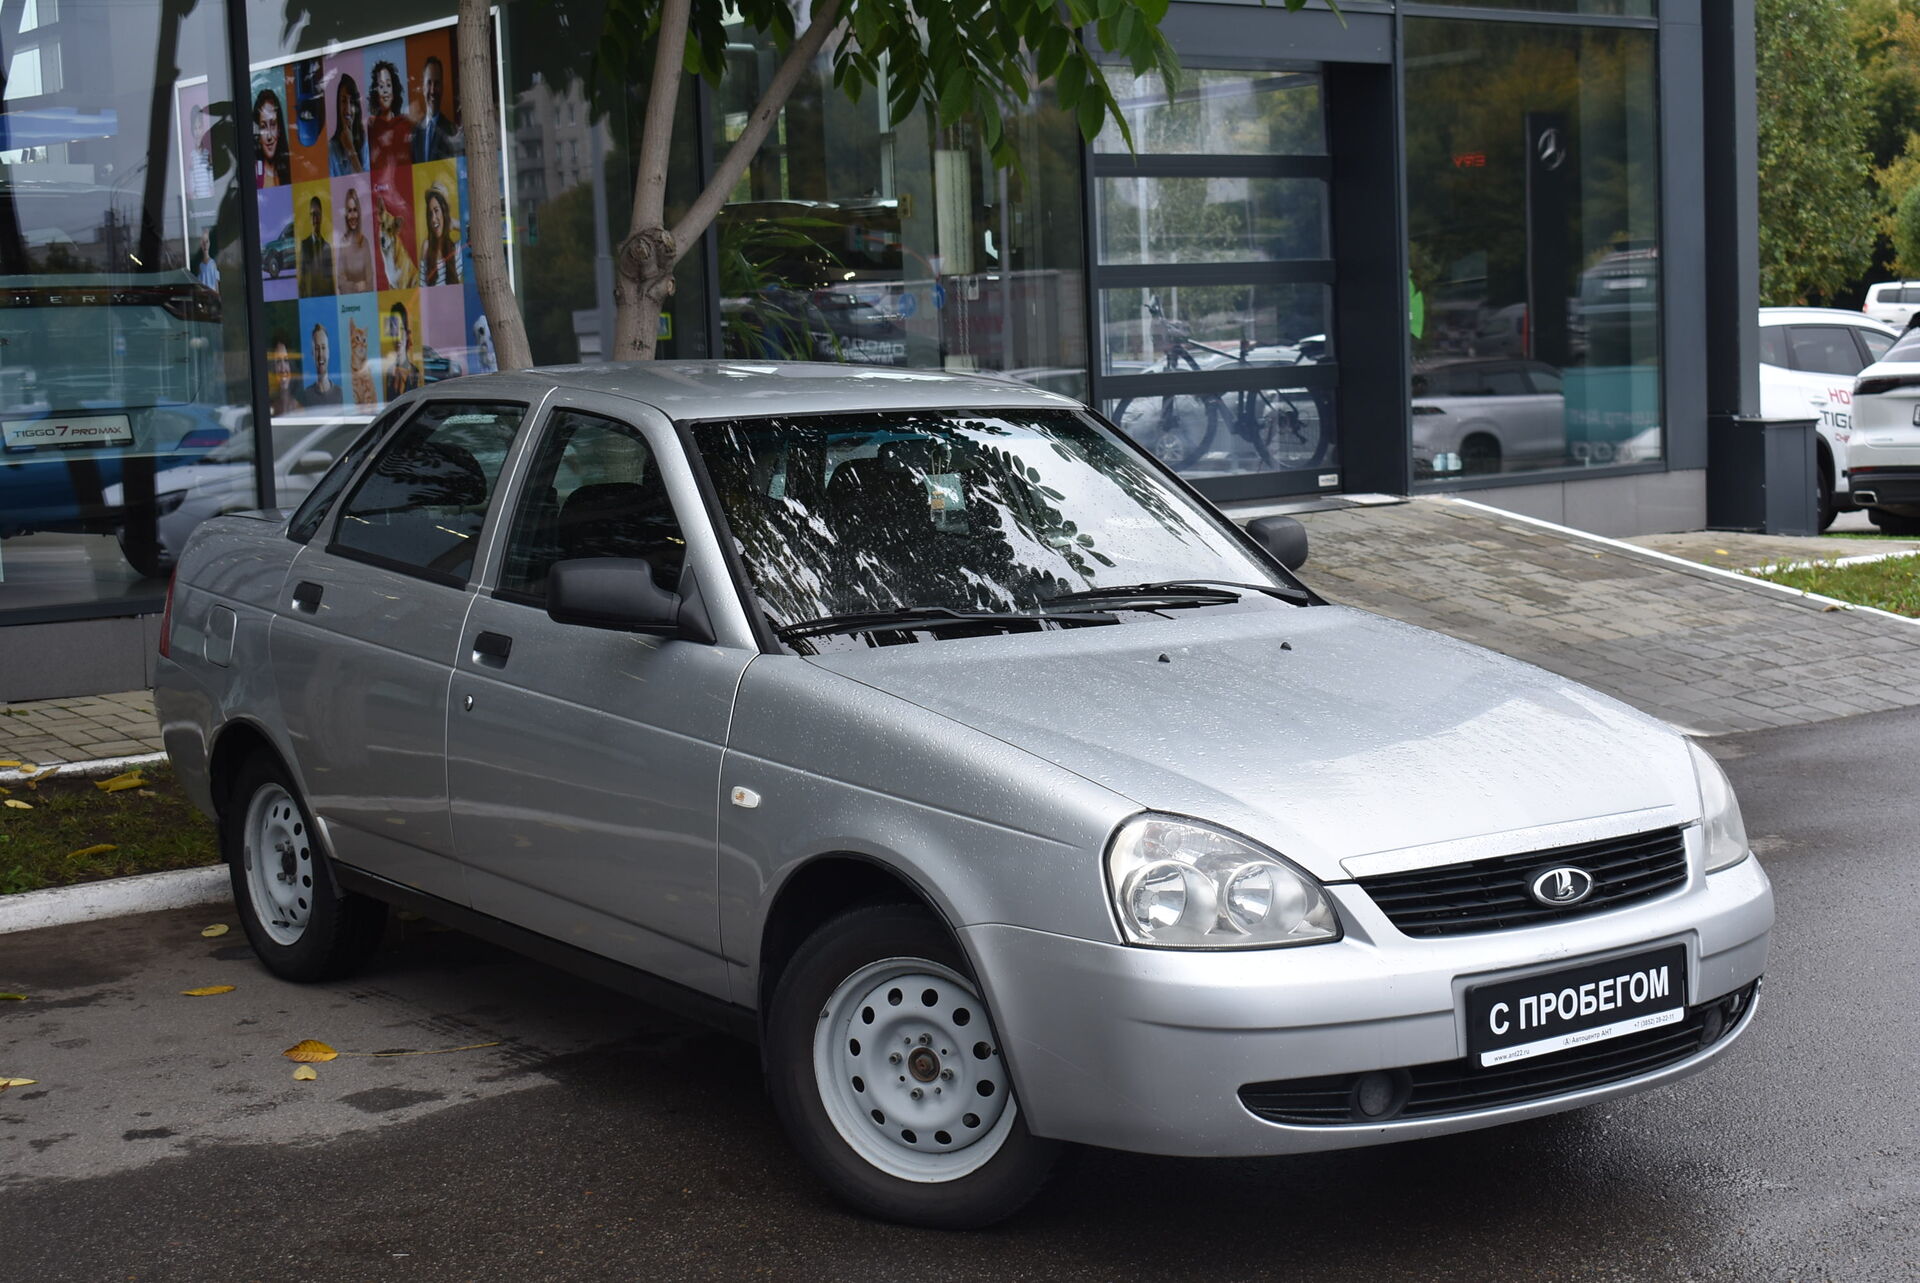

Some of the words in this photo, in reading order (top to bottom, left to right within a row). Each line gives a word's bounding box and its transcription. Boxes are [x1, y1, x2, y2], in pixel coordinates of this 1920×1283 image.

[13, 428, 56, 438] TIGGO
[55, 425, 69, 436] 7
[71, 427, 98, 436] PRO
[98, 426, 122, 435] MAX
[1489, 1002, 1510, 1035] С
[1519, 966, 1669, 1029] ПРОБЕГОМ
[1572, 1032, 1600, 1043] Автоцентр
[1601, 1027, 1612, 1036] АНТ
[1494, 1050, 1530, 1061] www.ant22.ru
